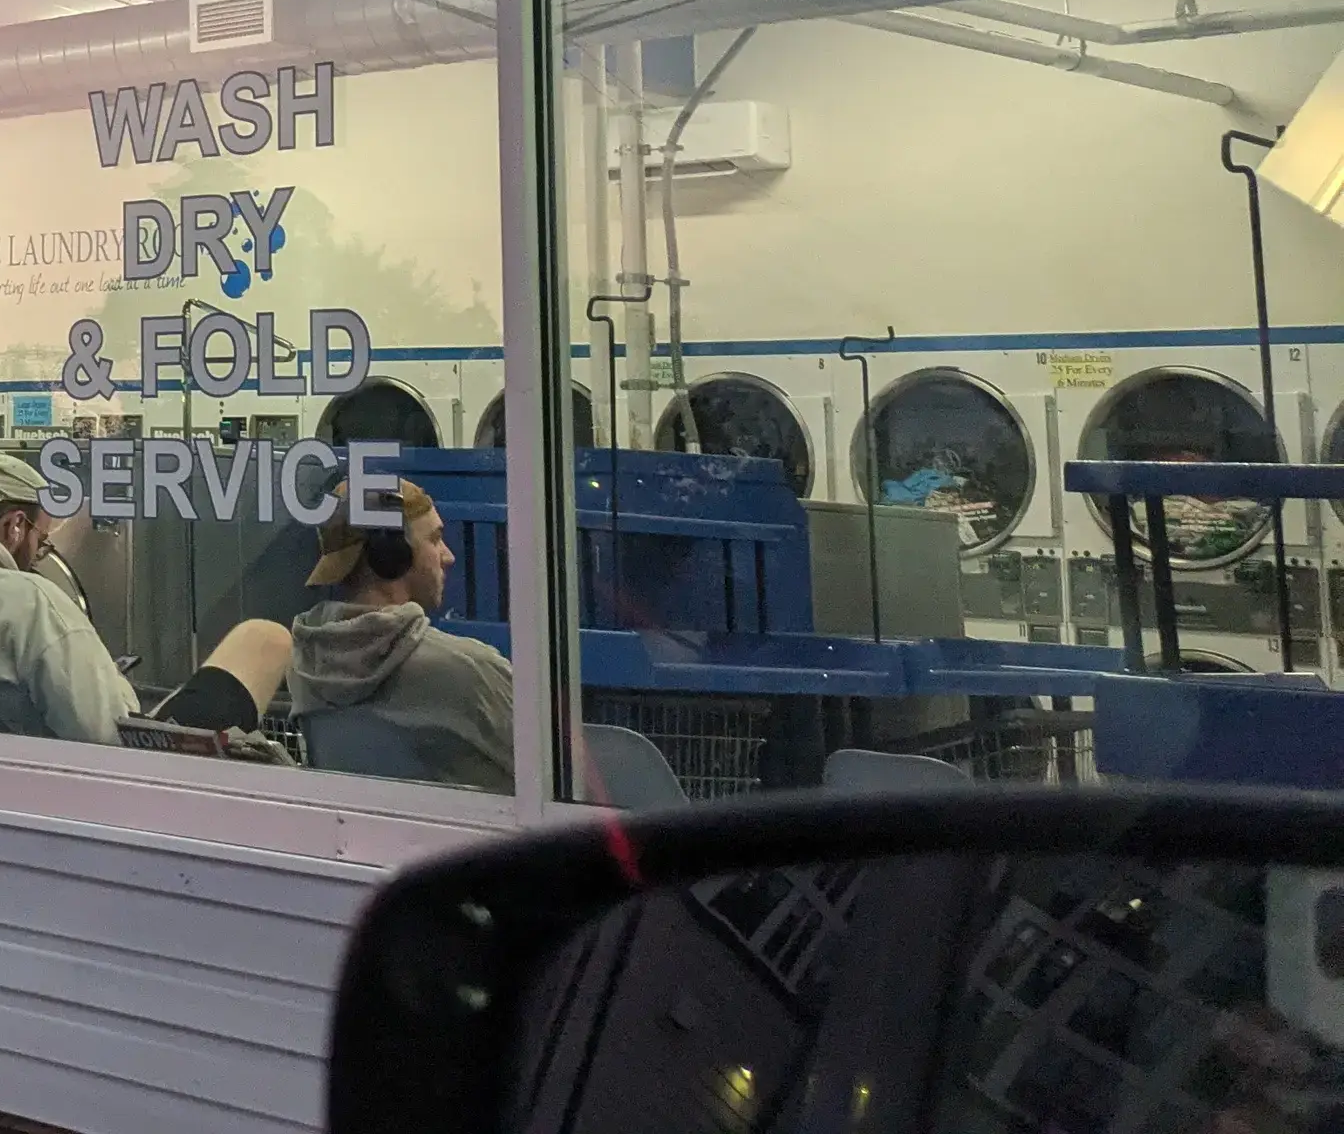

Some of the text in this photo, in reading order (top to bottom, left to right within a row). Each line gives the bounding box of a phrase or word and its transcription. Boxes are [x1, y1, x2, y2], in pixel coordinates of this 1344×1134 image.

[88, 61, 335, 168] WASH
[8, 227, 124, 267] LAUNDRY
[122, 186, 296, 281] DRY
[28, 272, 45, 296] life
[50, 275, 70, 294] out
[74, 279, 93, 293] one
[99, 271, 123, 291] load
[157, 274, 186, 289] time
[62, 308, 372, 401] & FOLD
[1036, 352, 1047, 365] 10
[1290, 347, 1300, 361] 12
[154, 429, 215, 441] Huech
[36, 436, 404, 528] SERVICE
